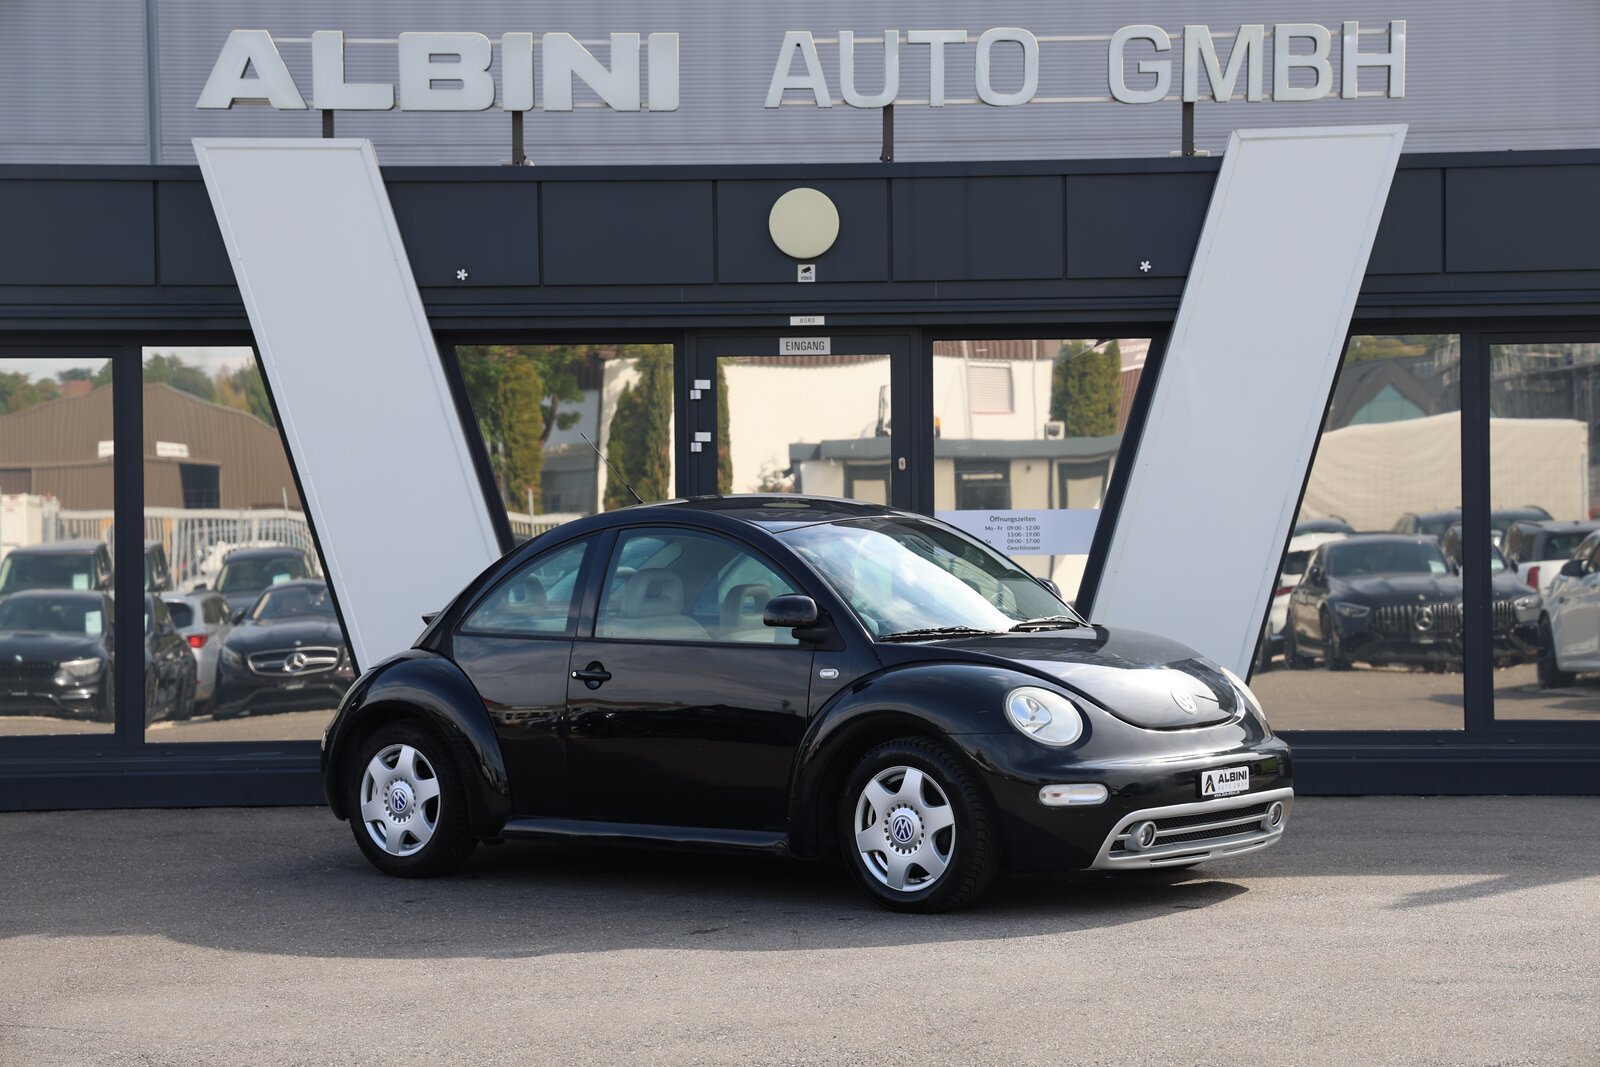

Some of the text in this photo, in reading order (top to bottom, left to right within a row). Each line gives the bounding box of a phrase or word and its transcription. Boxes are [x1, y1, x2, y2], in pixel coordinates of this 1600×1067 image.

[196, 20, 1407, 112] ALBINI AUTO GMBH
[785, 341, 825, 351] EINGANG
[1218, 770, 1247, 784] ALBINI
